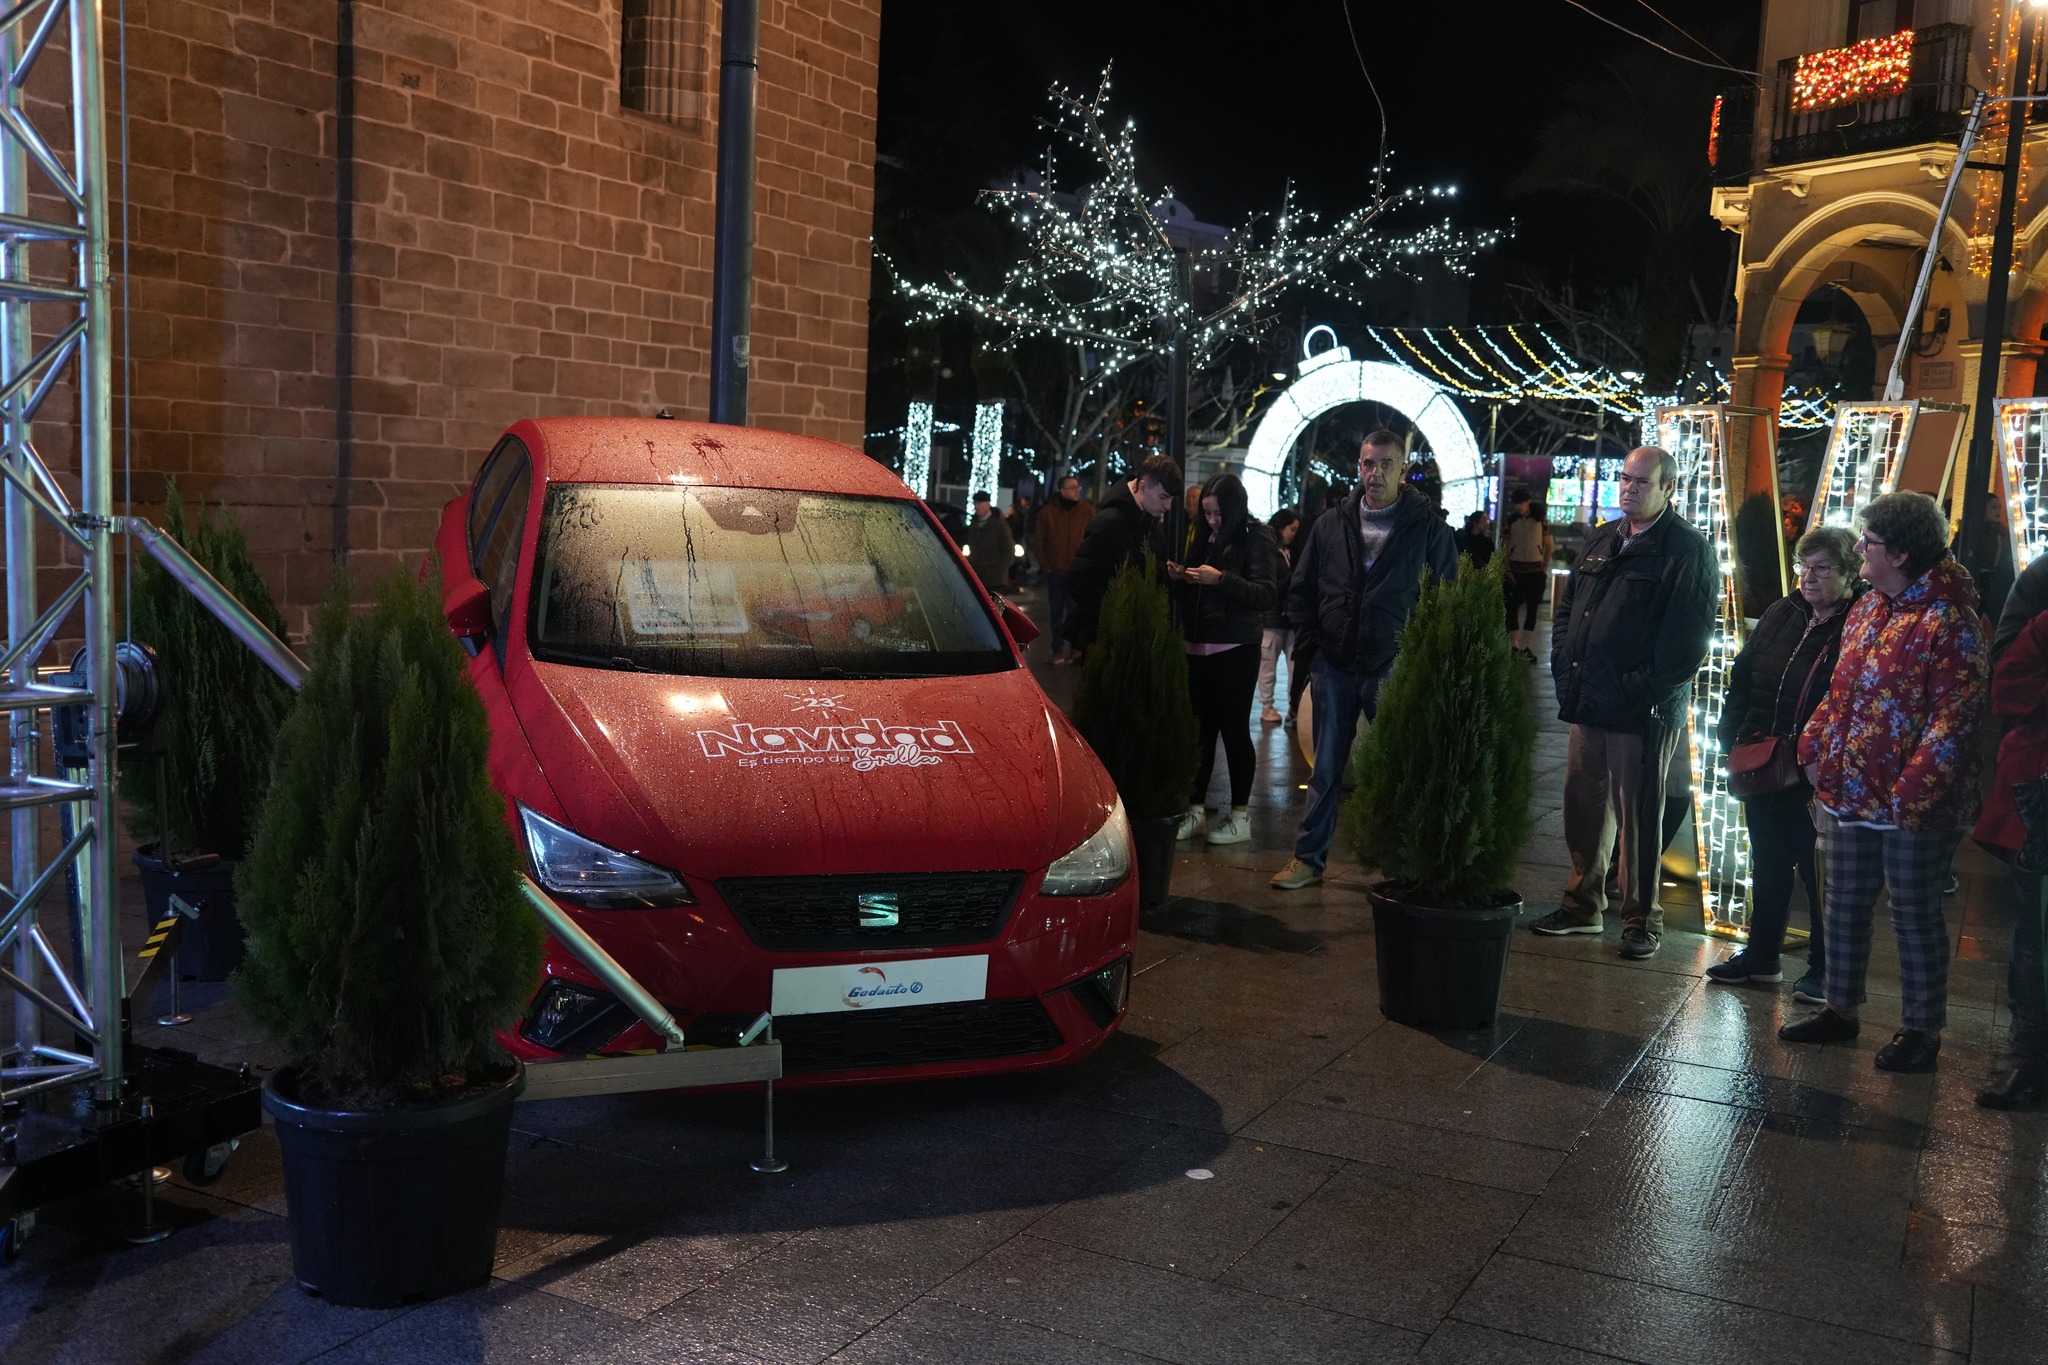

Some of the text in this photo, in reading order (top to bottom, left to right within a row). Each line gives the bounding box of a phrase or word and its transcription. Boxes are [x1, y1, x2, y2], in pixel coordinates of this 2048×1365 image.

[803, 697, 836, 708] 23
[697, 718, 975, 757] Navidad
[738, 758, 758, 768] Es
[763, 754, 825, 765] tiempo
[828, 754, 851, 763] de
